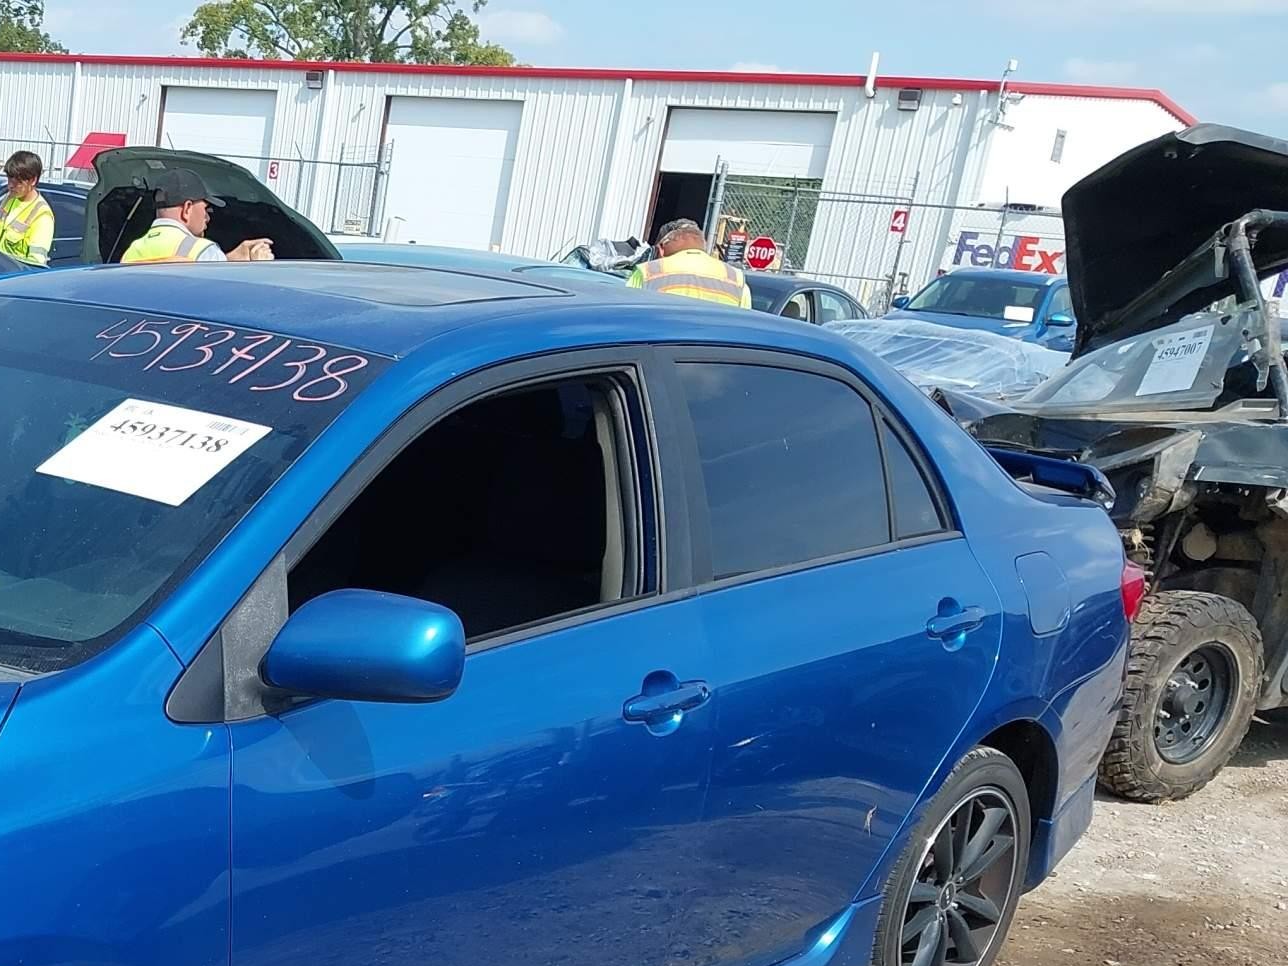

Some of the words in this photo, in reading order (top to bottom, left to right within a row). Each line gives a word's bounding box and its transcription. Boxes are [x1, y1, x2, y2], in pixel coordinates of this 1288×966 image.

[892, 213, 905, 231] 4
[748, 246, 776, 260] STOP
[952, 231, 1064, 274] FedEx
[90, 319, 368, 401] 45937138
[110, 419, 229, 452] 45937138
